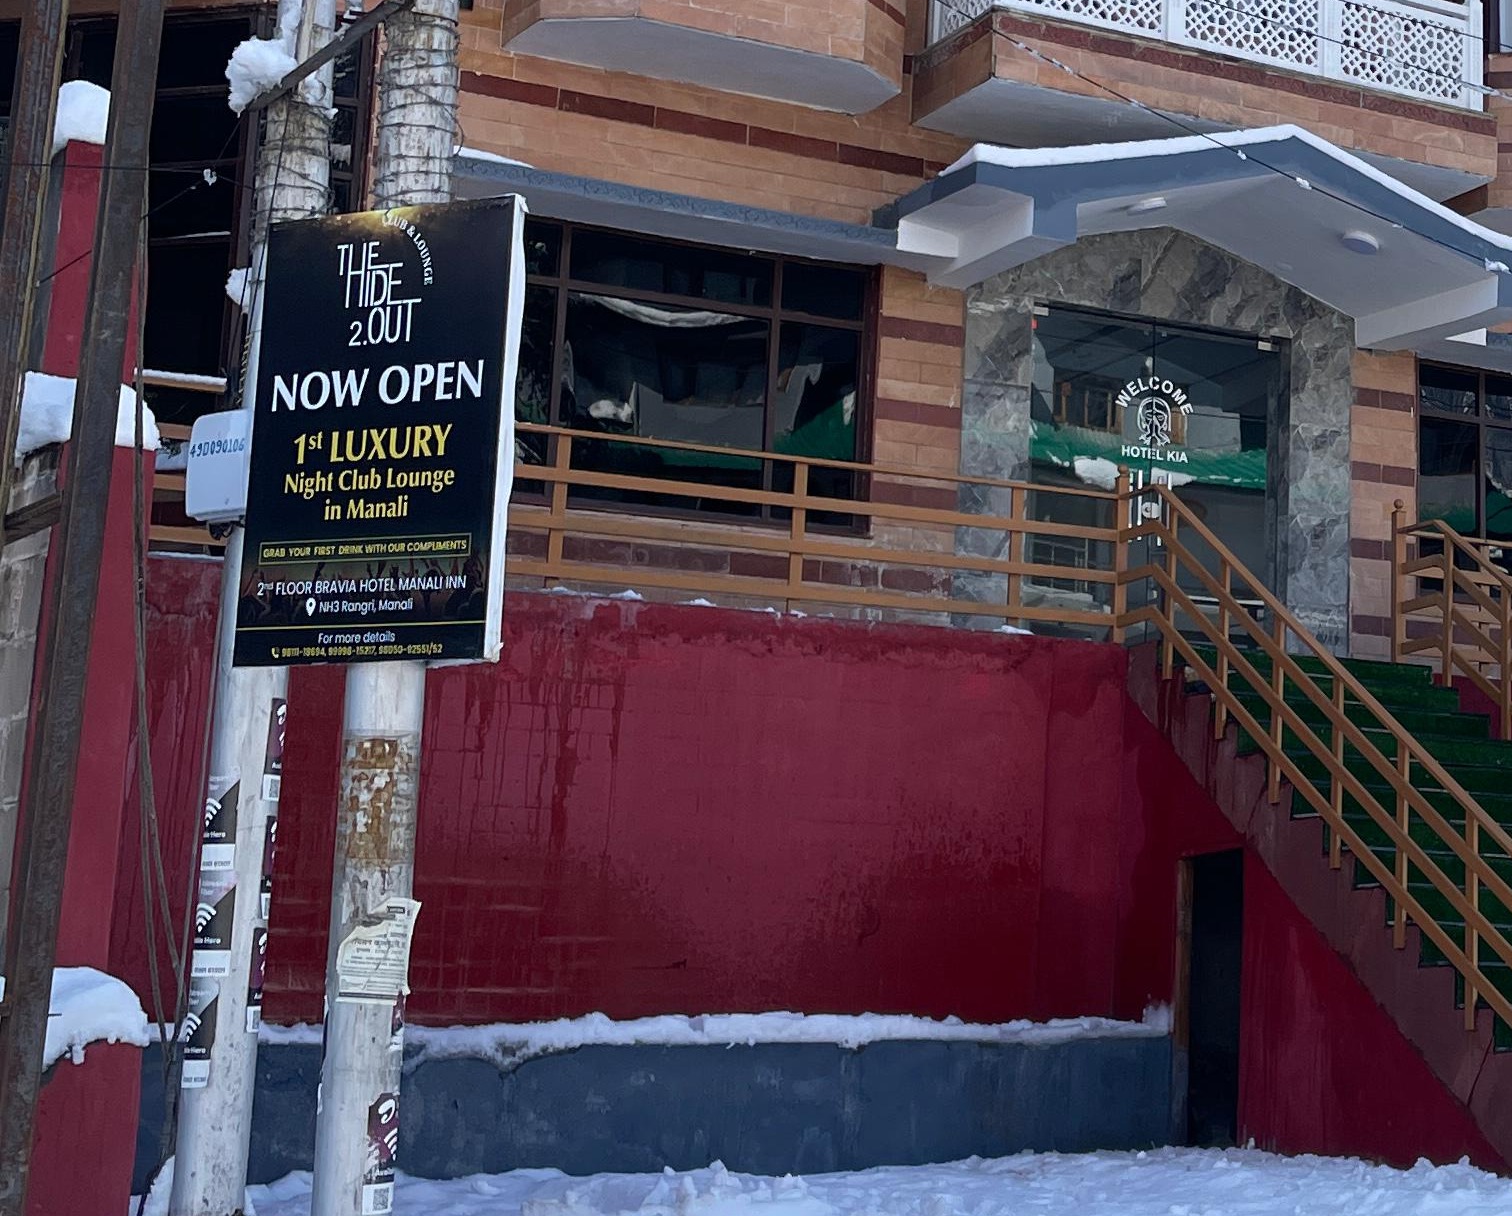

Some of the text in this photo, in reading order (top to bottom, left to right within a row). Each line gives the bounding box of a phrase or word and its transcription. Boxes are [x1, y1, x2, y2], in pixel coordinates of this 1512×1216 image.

[406, 225, 417, 237] &
[413, 233, 434, 286] LOUNGE
[345, 262, 404, 308] HIDE
[271, 359, 484, 412] NOW OPEN
[1115, 376, 1194, 416] WELCOME
[293, 423, 453, 465] 1st LUXURY
[1121, 445, 1189, 464] HOTEL KIA
[284, 468, 455, 500] Night Club Lounge
[324, 495, 409, 521] in Manali
[263, 540, 467, 559] GRAB YOUR FIRST DRINK WITH OUR COMPLIMENTS
[256, 575, 467, 596] 2nd FLOOR BRAVIA HOTEL MANALI INN
[319, 597, 414, 615] NH3 Rangri, Manali
[317, 631, 396, 644] For more details
